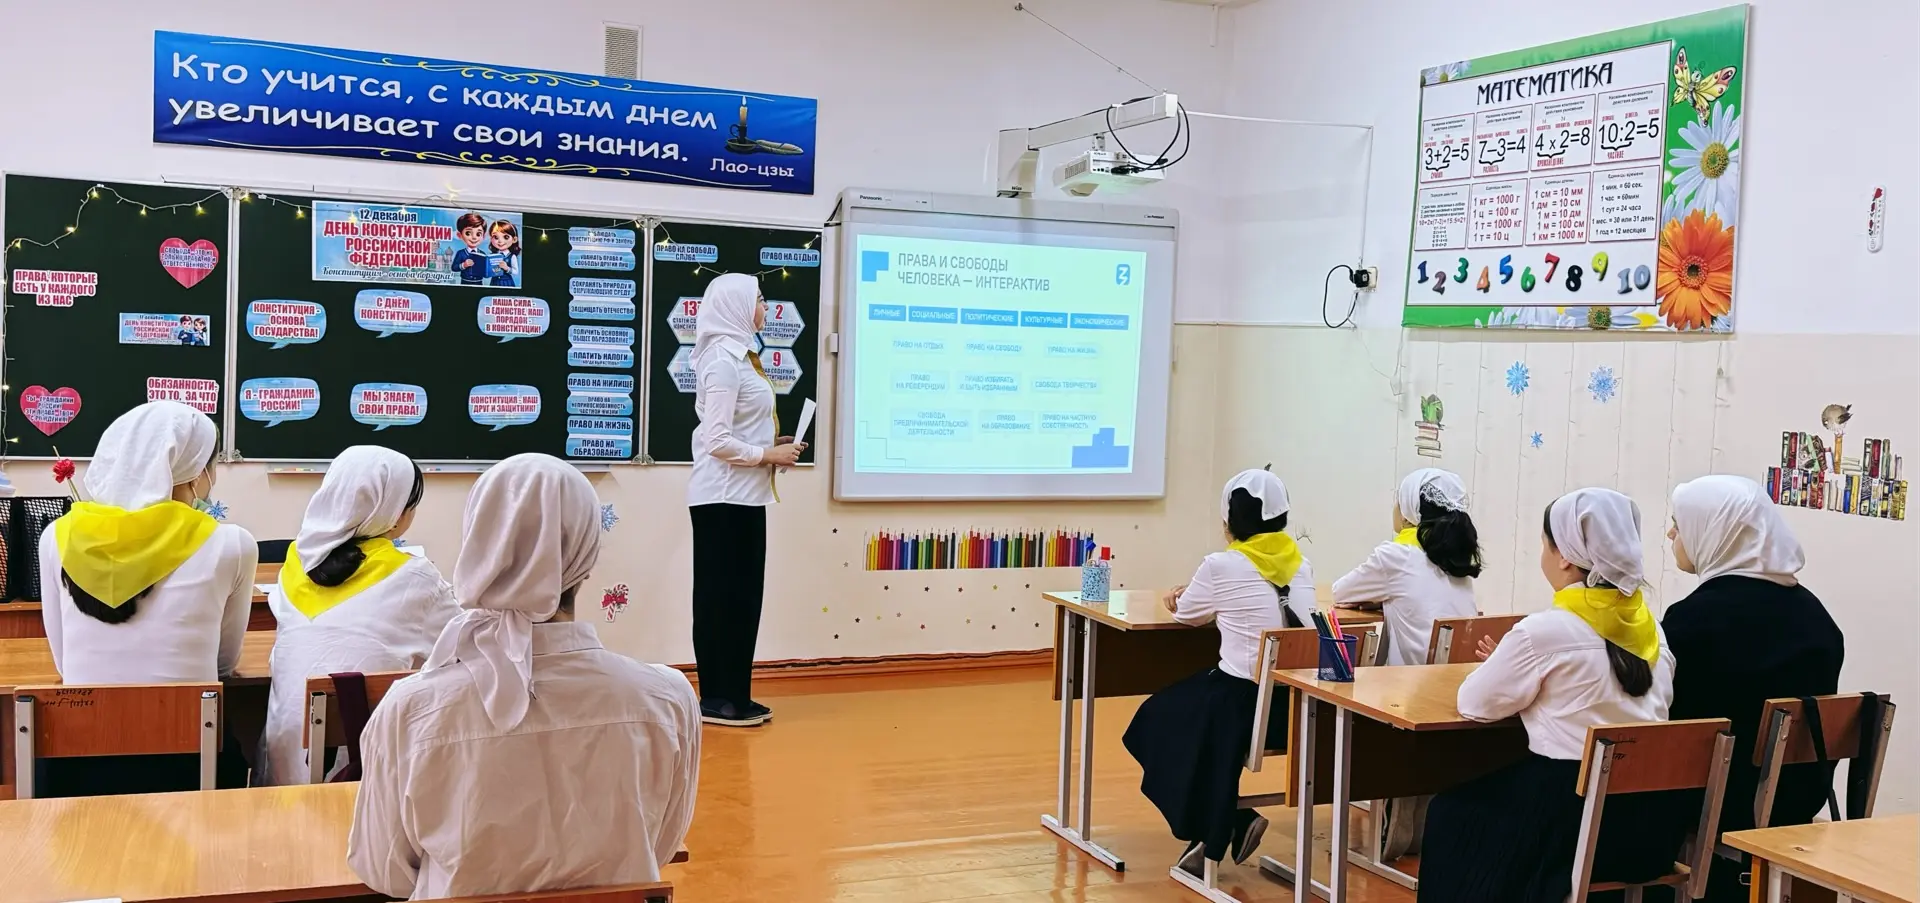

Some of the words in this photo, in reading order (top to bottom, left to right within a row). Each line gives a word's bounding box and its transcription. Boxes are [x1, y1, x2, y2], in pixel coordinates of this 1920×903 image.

[1476, 61, 1613, 105] МАТЕМАТИКА
[172, 53, 248, 84] Кто
[265, 67, 414, 102] учится,
[429, 84, 447, 102] с
[463, 86, 614, 119] каждым
[626, 104, 717, 131] днем
[171, 98, 439, 138] увеличивает
[454, 124, 543, 147] свои
[558, 133, 689, 162] знания.
[1598, 117, 1660, 144] 10:2=5
[1425, 143, 1469, 165] 3+2=5
[710, 158, 794, 179] Лао-цзы
[1479, 198, 1487, 206] кг
[1496, 194, 1514, 205] 1000
[1516, 195, 1520, 203] г
[360, 209, 370, 220] 12
[372, 211, 417, 222] декабря
[1605, 206, 1615, 215] сут
[1620, 204, 1628, 212] 24
[1628, 204, 1642, 212] часа
[324, 221, 359, 237] ДЕНЬ
[361, 222, 452, 241] КОНСТИТУЦИИ
[1538, 233, 1549, 241] км
[1558, 229, 1576, 240] 1000
[1577, 231, 1584, 239] м
[345, 237, 431, 255] РОССИЙСКОЙ
[656, 245, 677, 253] ПРАВО
[677, 245, 686, 253] НА
[686, 246, 716, 255] СВОБОДУ
[349, 252, 427, 269] ФЕДЕРАЦИИ
[761, 251, 783, 260] ПРАВО
[783, 252, 792, 261] НА
[793, 253, 818, 262] ОТДЫХ
[898, 253, 937, 267] ПРАВА
[939, 255, 947, 268] И
[950, 256, 1008, 273] СВОБОДЫ
[15, 271, 49, 282] ПРАВА,
[51, 272, 96, 284] КОТОРЫЕ
[323, 266, 382, 279] Конституция
[388, 271, 414, 279] основа
[1417, 260, 1429, 283] 1
[1432, 271, 1447, 295] 2
[1453, 257, 1469, 283] 3
[1476, 265, 1490, 293] 4
[1500, 254, 1513, 284] 5
[1521, 266, 1536, 293] 6
[1545, 252, 1560, 283] 7
[1566, 264, 1583, 292] 8
[1591, 251, 1609, 282] 9
[1617, 264, 1651, 295] 10
[602, 282, 628, 290] ПРИРОДУ
[897, 271, 960, 287] ЧЕЛОВЕКА
[975, 275, 1050, 291] ИНТЕРАКТИВ
[15, 282, 38, 293] ЕСТЬ
[40, 283, 47, 293] У
[48, 284, 95, 296] КАЖДОГО
[38, 295, 51, 305] ИЗ
[53, 295, 72, 306] НАС
[376, 297, 383, 307] С
[384, 297, 410, 309] ДНЁМ
[492, 298, 513, 307] НАША
[513, 299, 532, 307] СИЛА
[253, 303, 315, 316] КОНСТИТУЦИЯ
[485, 307, 491, 315] В
[528, 308, 544, 317] НАШ
[603, 307, 634, 315] ОТЕЧЕСТВО
[775, 304, 783, 320] 2
[911, 310, 956, 320] СОЦИАЛЬНЫЕ
[270, 315, 306, 326] ОСНОВА
[361, 310, 427, 323] КОНСТИТУЦИИ!
[496, 316, 528, 325] ПОРЯДОК
[964, 312, 1014, 323] ПОЛИТИЧЕСКИЕ
[1024, 315, 1063, 325] КУЛЬТУРНЫЕ
[1074, 317, 1125, 327] ЭКОНОМИЧЕСКИЕ
[255, 326, 318, 338] ГОСУДАРСТВА!
[486, 324, 491, 332] В
[491, 324, 541, 334] КОНСТИТУЦИИ!
[893, 340, 913, 348] ПРАВО
[573, 352, 602, 360] ПЛАТИТЬ
[603, 353, 628, 361] НАЛОГИ
[773, 352, 781, 367] 9
[568, 378, 591, 387] ПРАВО
[592, 379, 601, 387] НА
[602, 380, 633, 389] ЖИЛИЩЕ
[149, 389, 166, 400] ЭТО
[186, 391, 197, 401] ЗА
[199, 391, 217, 402] ЧТО
[245, 389, 252, 400] Я
[258, 389, 315, 401] ГРАЖДАНИН
[363, 391, 382, 402] МЫ
[383, 392, 415, 403] ЗНАЕМ
[470, 396, 518, 405] КОНСТИТУЦИЯ
[522, 396, 538, 405] НАШ
[260, 400, 301, 411] РОССИИ!
[358, 404, 384, 415] СВОИ
[385, 405, 419, 416] ПРАВА!
[473, 404, 490, 413] ДРУГ
[496, 404, 536, 413] ЗАЩИТНИК!
[569, 419, 593, 429] ПРАВО
[594, 420, 604, 429] НА
[604, 421, 631, 430] ЖИЗНЬ
[582, 439, 605, 448] ПРАВО
[605, 440, 615, 448] НА
[573, 448, 622, 457] ОБРАЗОВАНИЕ
